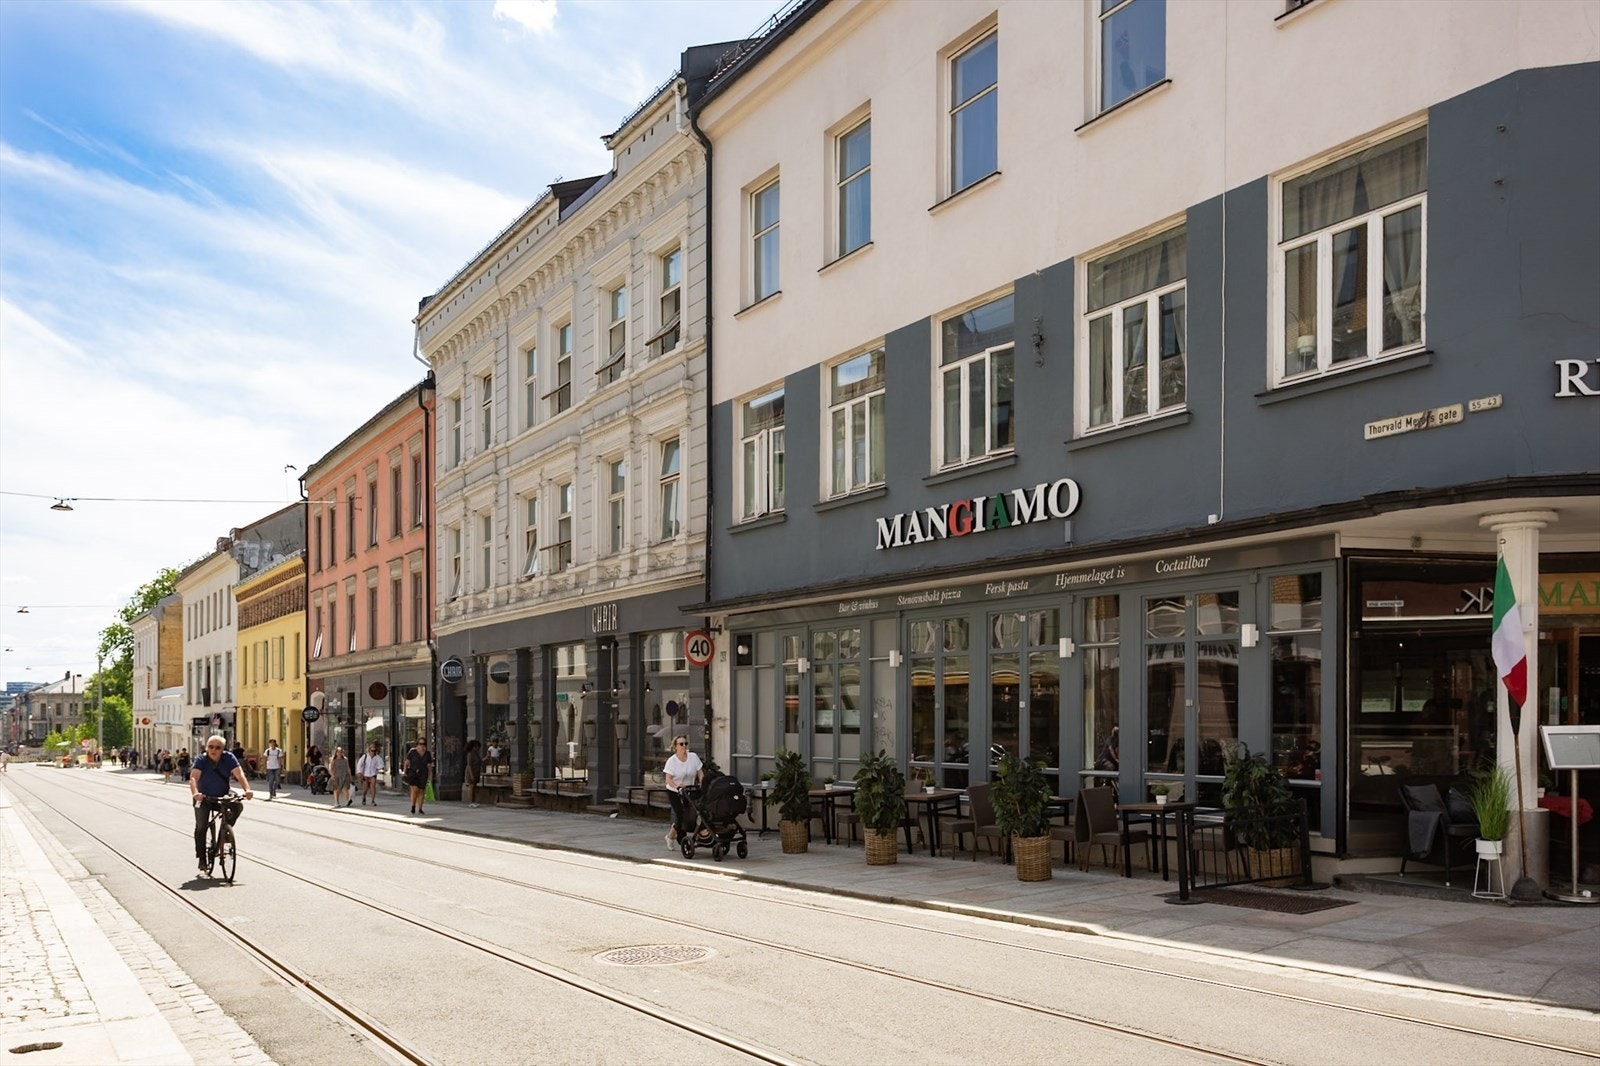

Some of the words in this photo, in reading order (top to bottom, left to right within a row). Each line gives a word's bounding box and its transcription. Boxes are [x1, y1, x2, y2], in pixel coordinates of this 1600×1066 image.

[1368, 420, 1402, 435] Thorvald
[1439, 409, 1457, 423] gate
[875, 477, 1081, 550] MANGIAMO
[1155, 554, 1211, 573] Coctailbar
[1055, 568, 1115, 589] Hjemmelaget
[1117, 565, 1126, 578] is
[940, 589, 962, 604] pizza
[985, 581, 1006, 595] Fersk
[1007, 580, 1029, 596] pasta
[838, 602, 850, 613] Bar
[851, 601, 858, 611] &
[591, 603, 618, 633] CHAIR
[690, 640, 710, 657] 40
